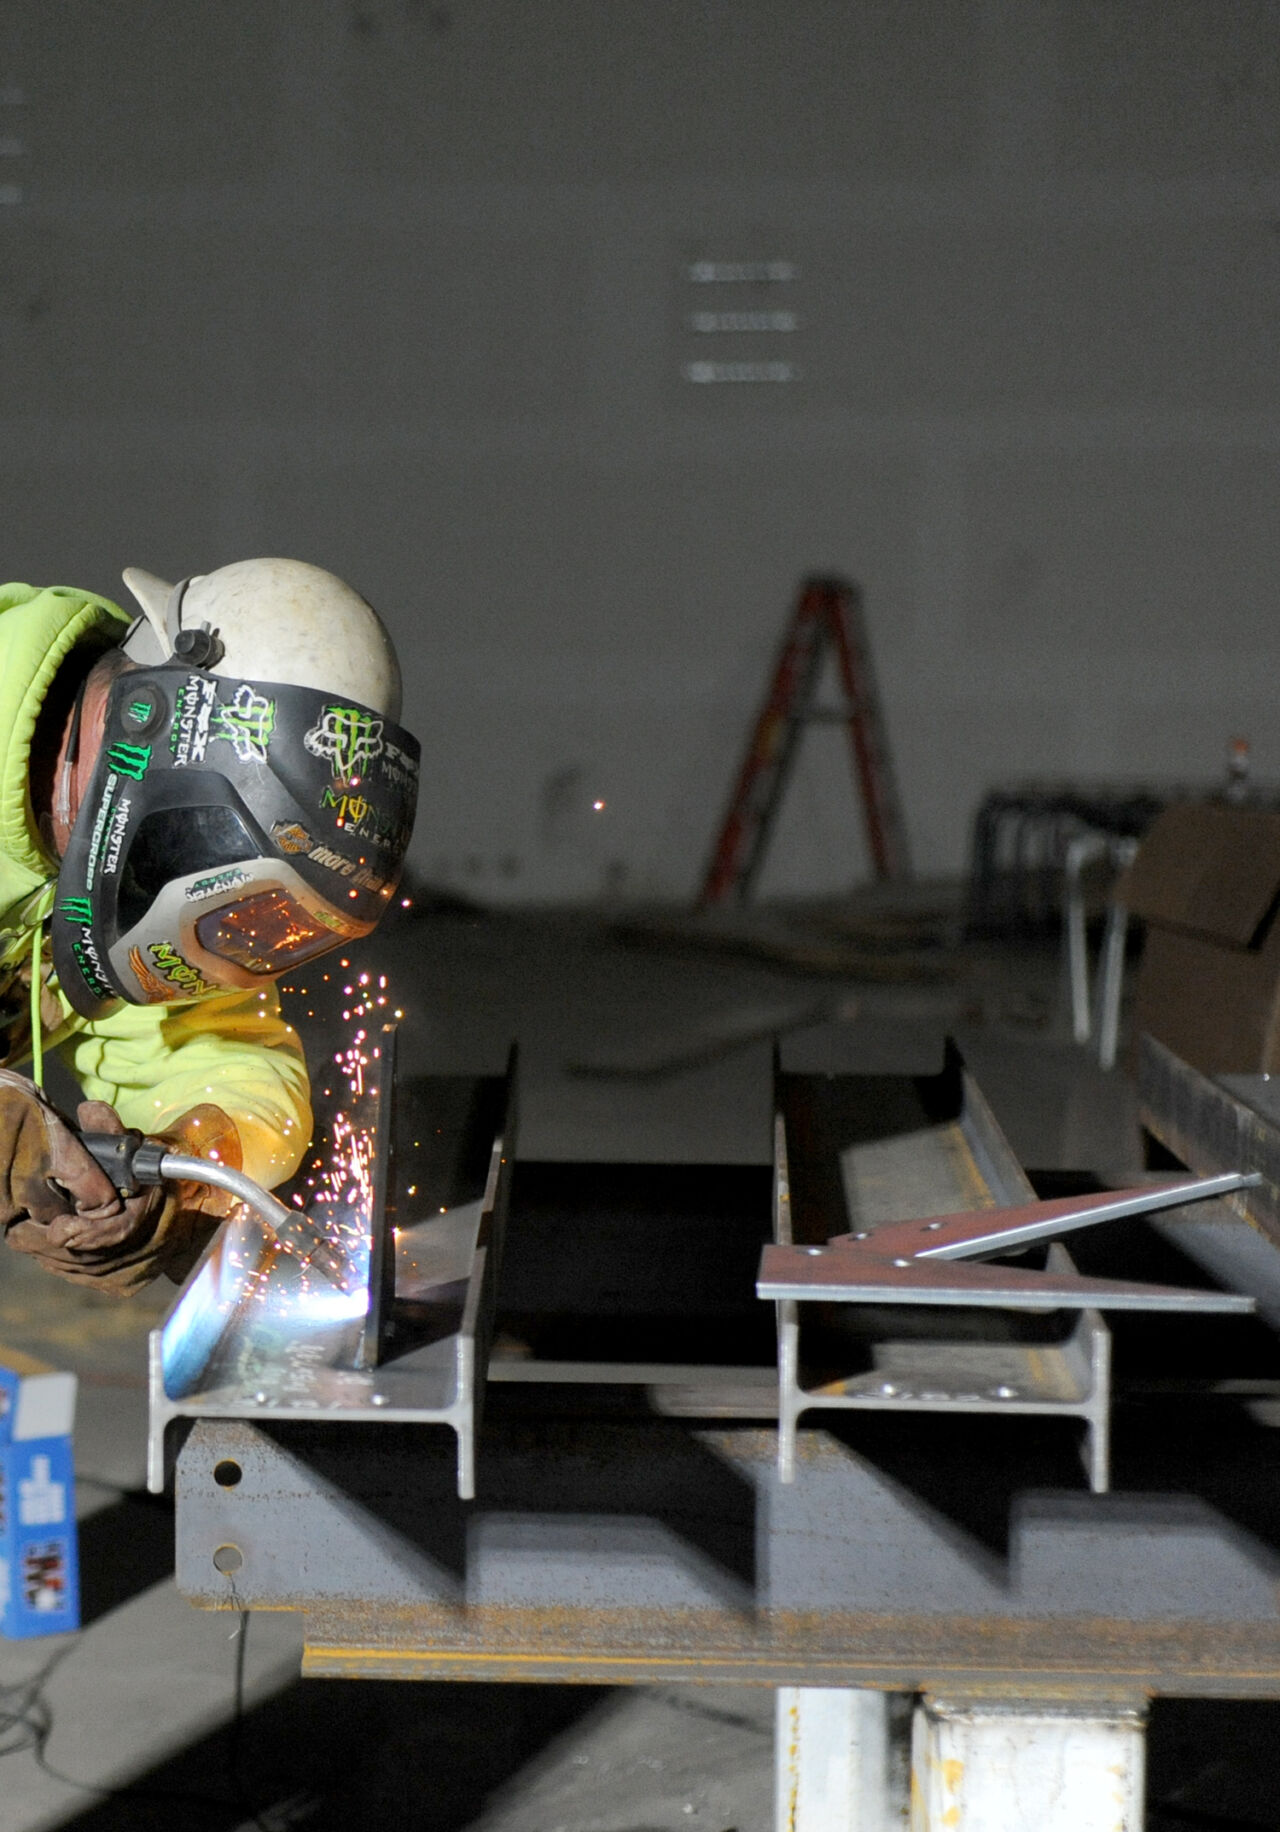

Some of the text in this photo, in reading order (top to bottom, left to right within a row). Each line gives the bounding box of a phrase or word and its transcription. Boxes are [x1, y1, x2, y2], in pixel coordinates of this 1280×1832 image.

[169, 688, 185, 753] ENERGY
[174, 675, 201, 767] MONSTER
[86, 773, 117, 891] SUPERCROSS
[104, 798, 131, 874] MONSTER
[308, 845, 356, 876] more
